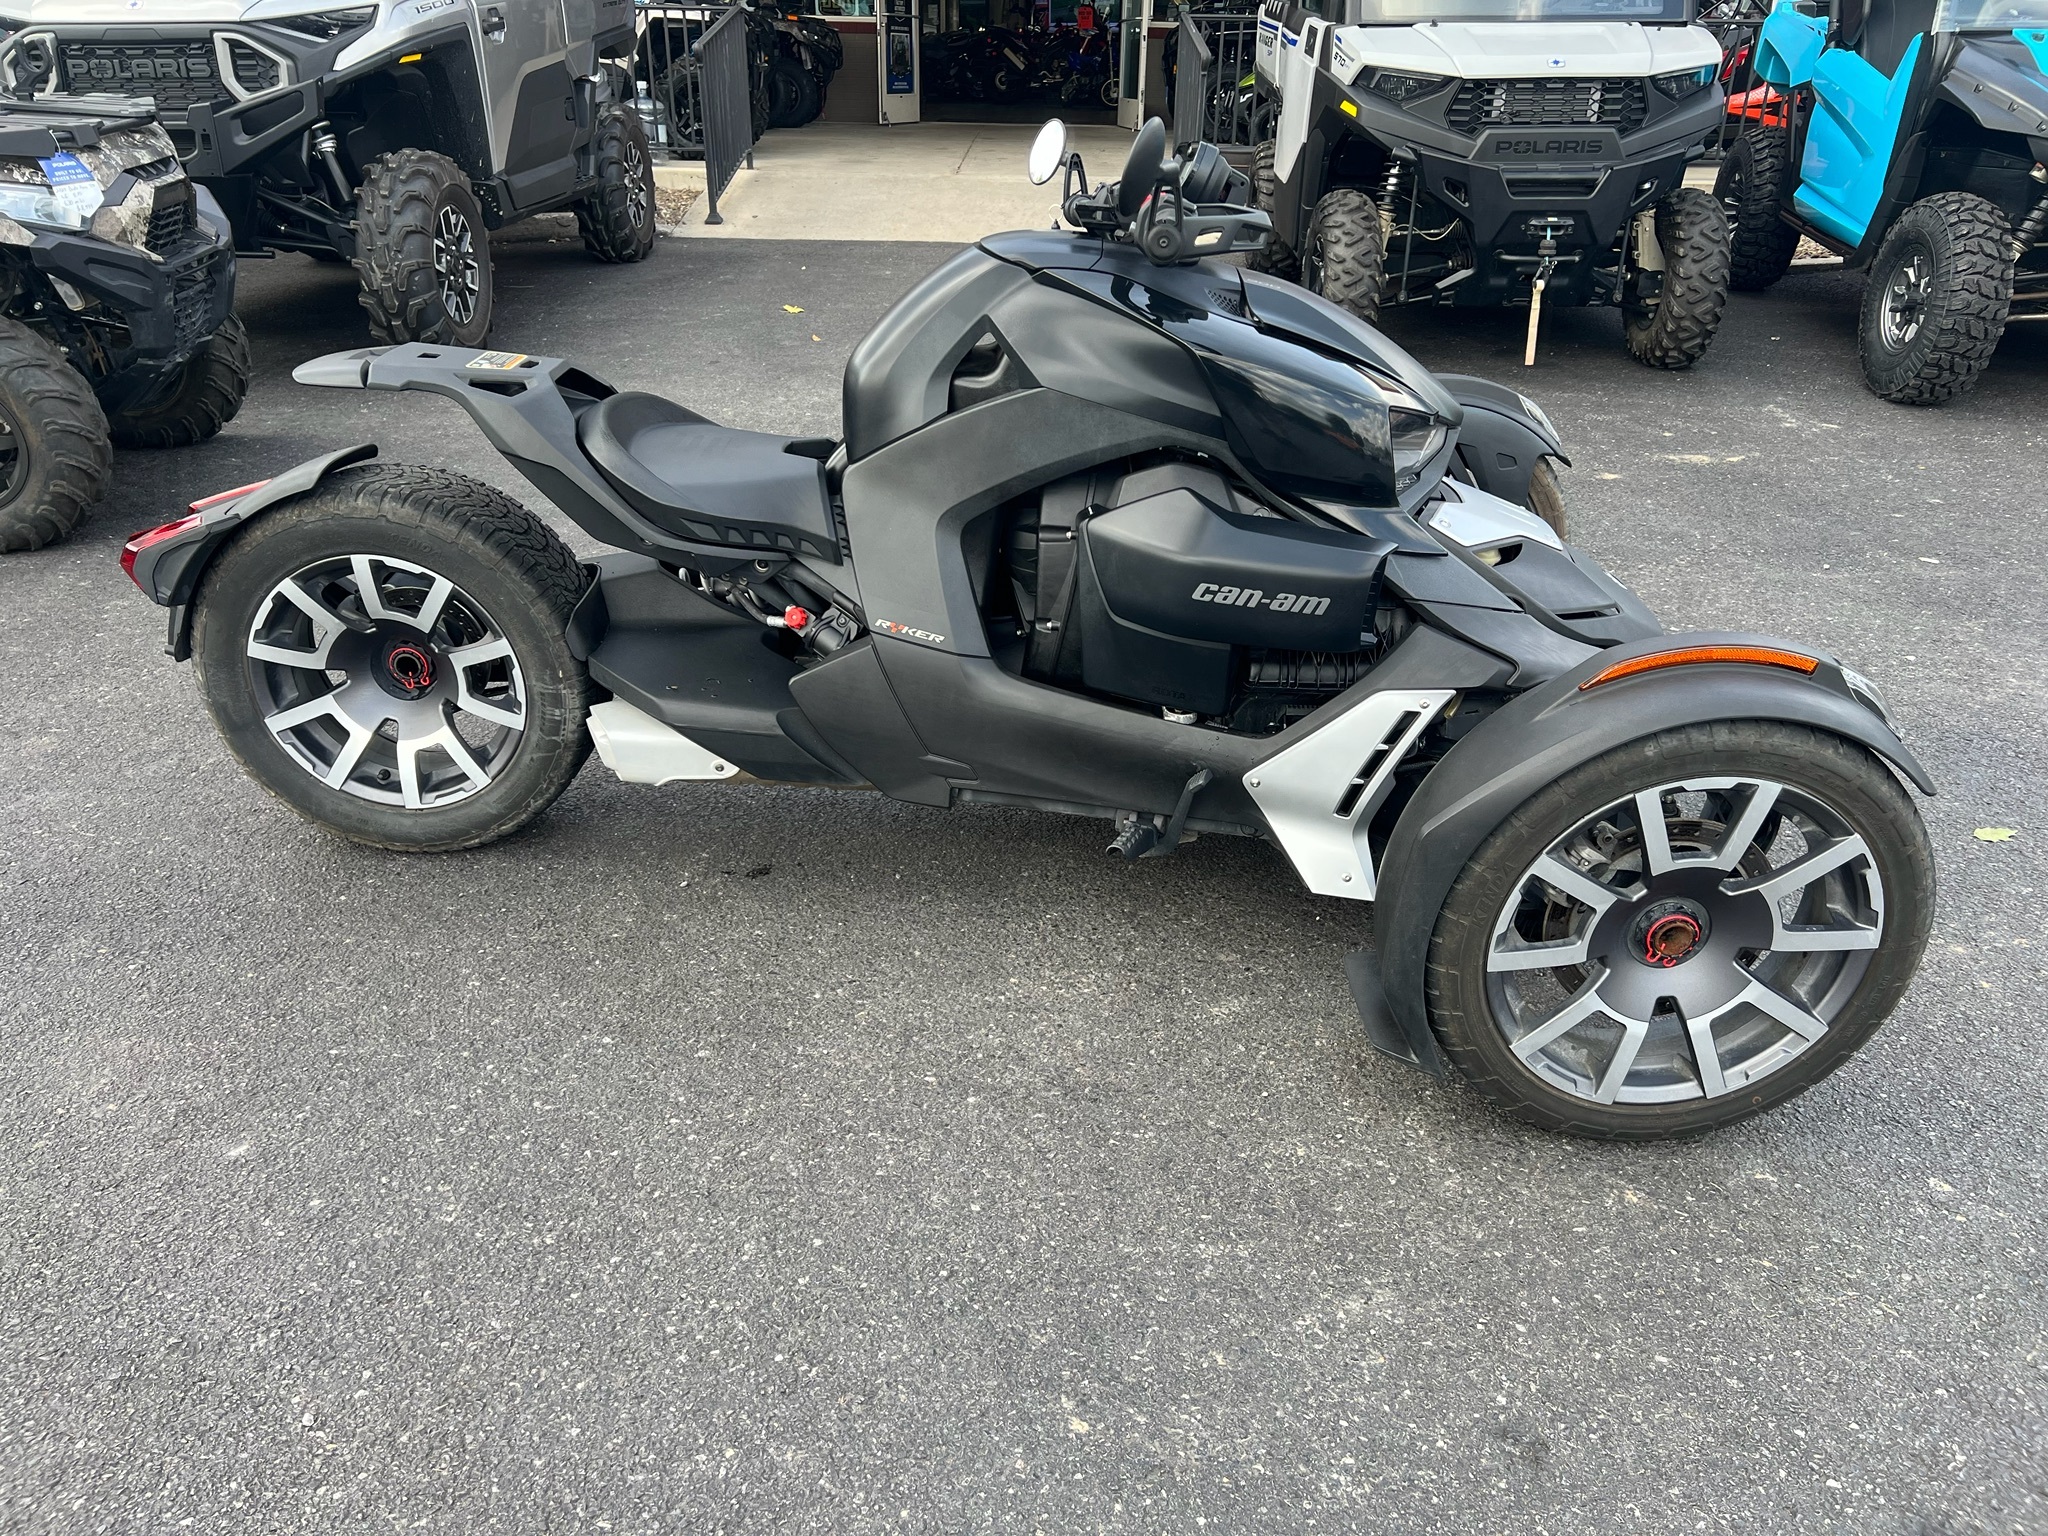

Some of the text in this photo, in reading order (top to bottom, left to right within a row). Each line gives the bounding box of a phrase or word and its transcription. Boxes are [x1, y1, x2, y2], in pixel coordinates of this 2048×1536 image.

[66, 58, 212, 79] POLARIS
[1333, 51, 1346, 67] 570
[1494, 139, 1604, 155] POLARIS
[1191, 582, 1331, 616] can-am
[874, 618, 946, 644] RYKER
